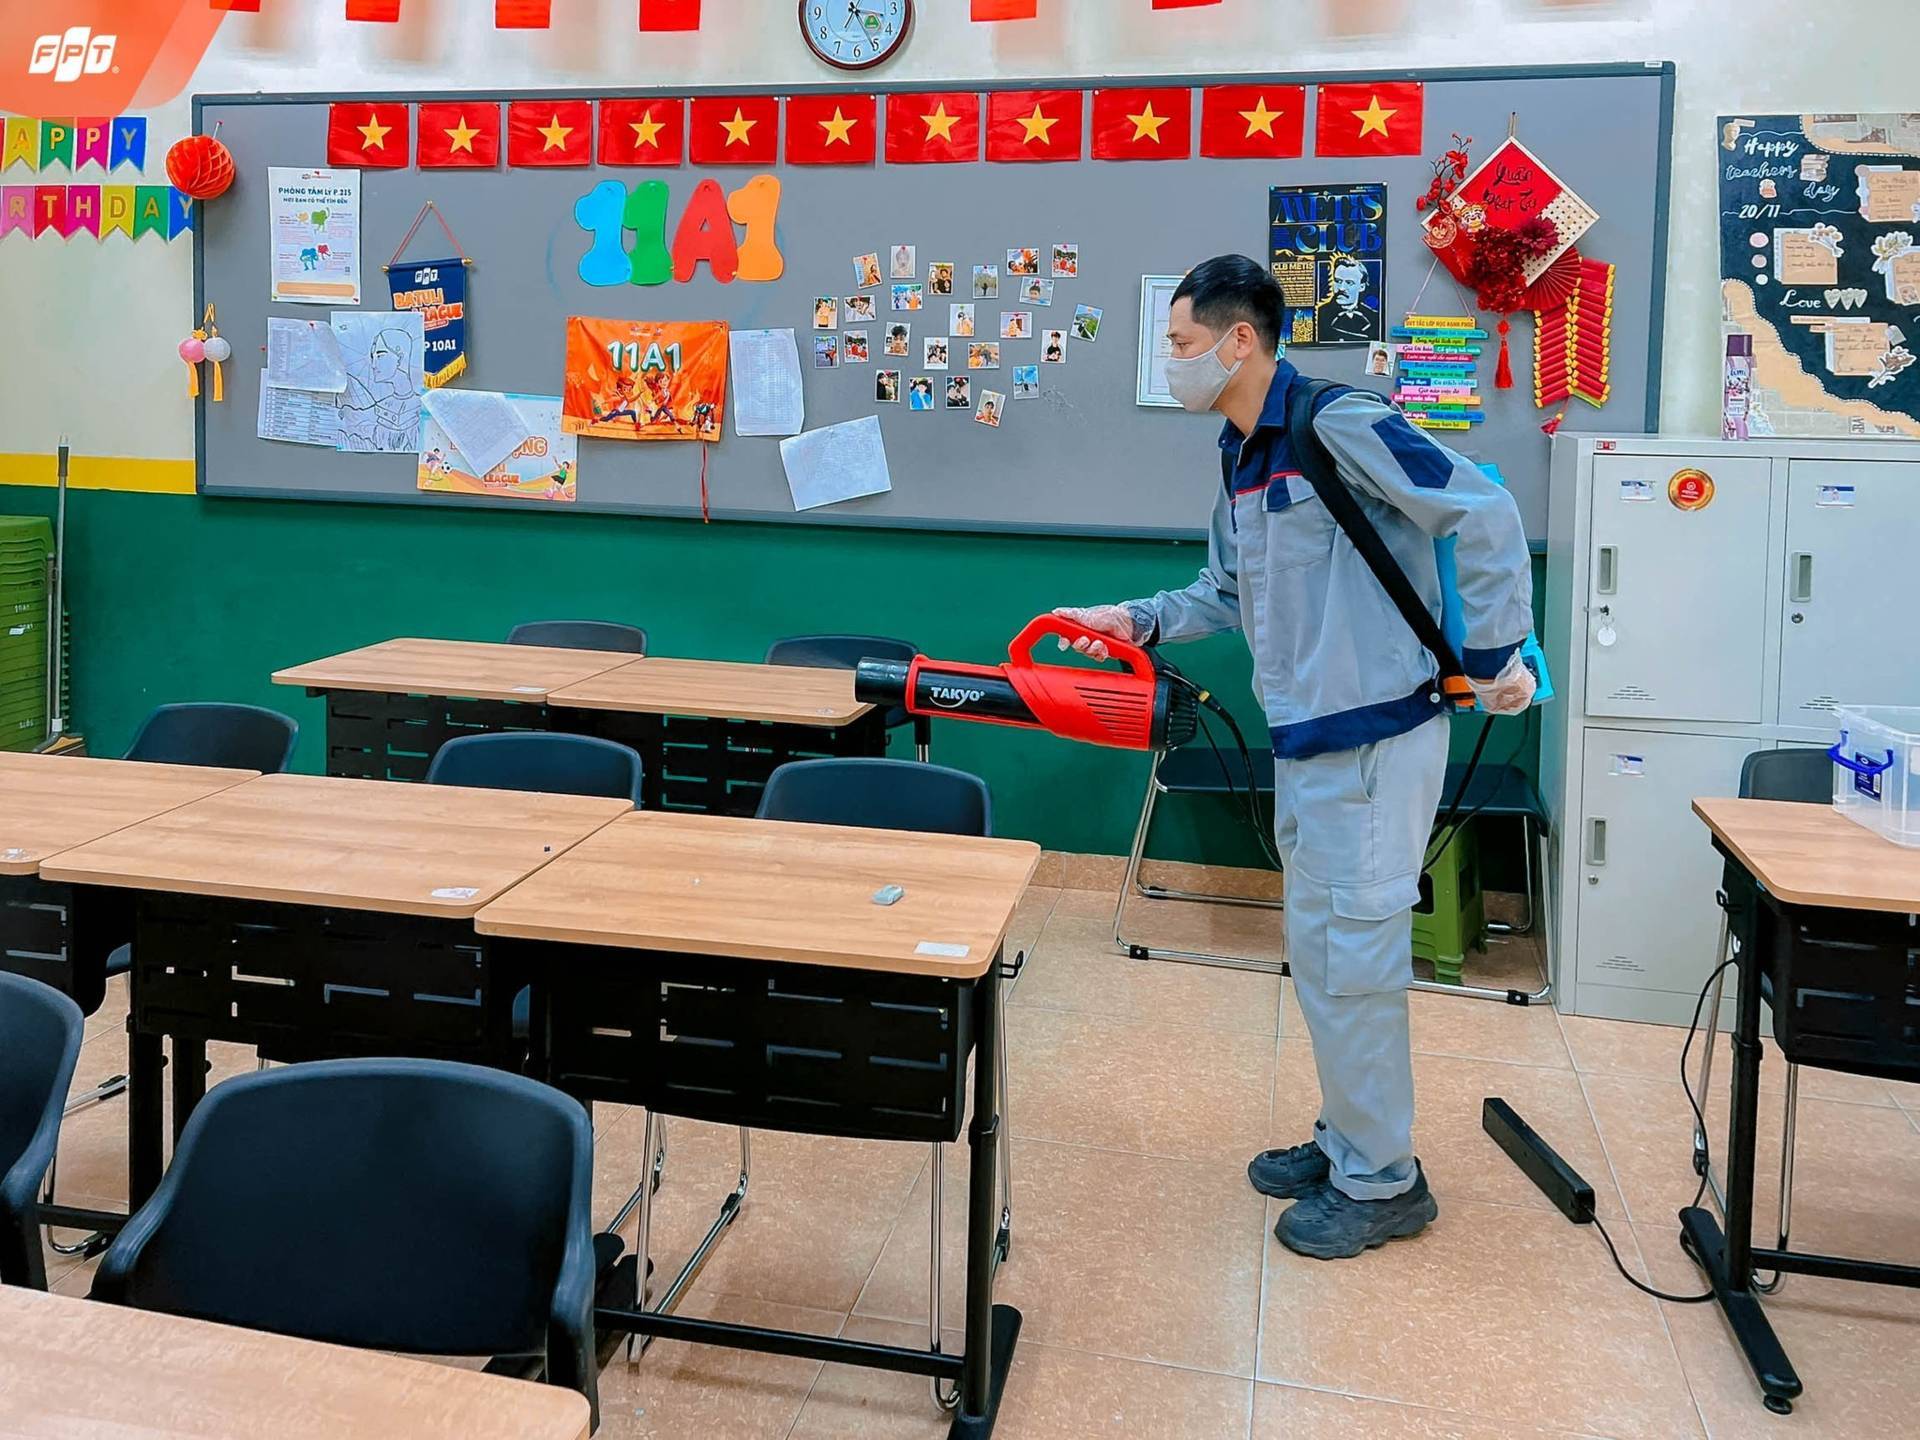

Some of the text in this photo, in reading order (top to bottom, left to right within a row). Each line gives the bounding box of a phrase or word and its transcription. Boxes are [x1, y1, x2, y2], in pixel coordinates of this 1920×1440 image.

[814, 6, 822, 20] 9
[890, 2, 898, 16] 3
[820, 26, 828, 40] 8
[885, 22, 893, 36] 4
[833, 40, 842, 54] 7
[853, 44, 861, 58] 6
[872, 38, 880, 51] 5
[1743, 137, 1800, 158] Happy
[1803, 181, 1840, 202] day
[1738, 204, 1781, 219] 20/11
[574, 174, 784, 287] 11A1
[1295, 222, 1383, 253] CLUB
[1273, 262, 1314, 270] CLB METIS
[414, 268, 439, 285] FPT
[1780, 289, 1821, 308] Love
[432, 339, 457, 352] 10A1
[607, 340, 682, 372] 11A1
[930, 686, 982, 704] TAKYO
